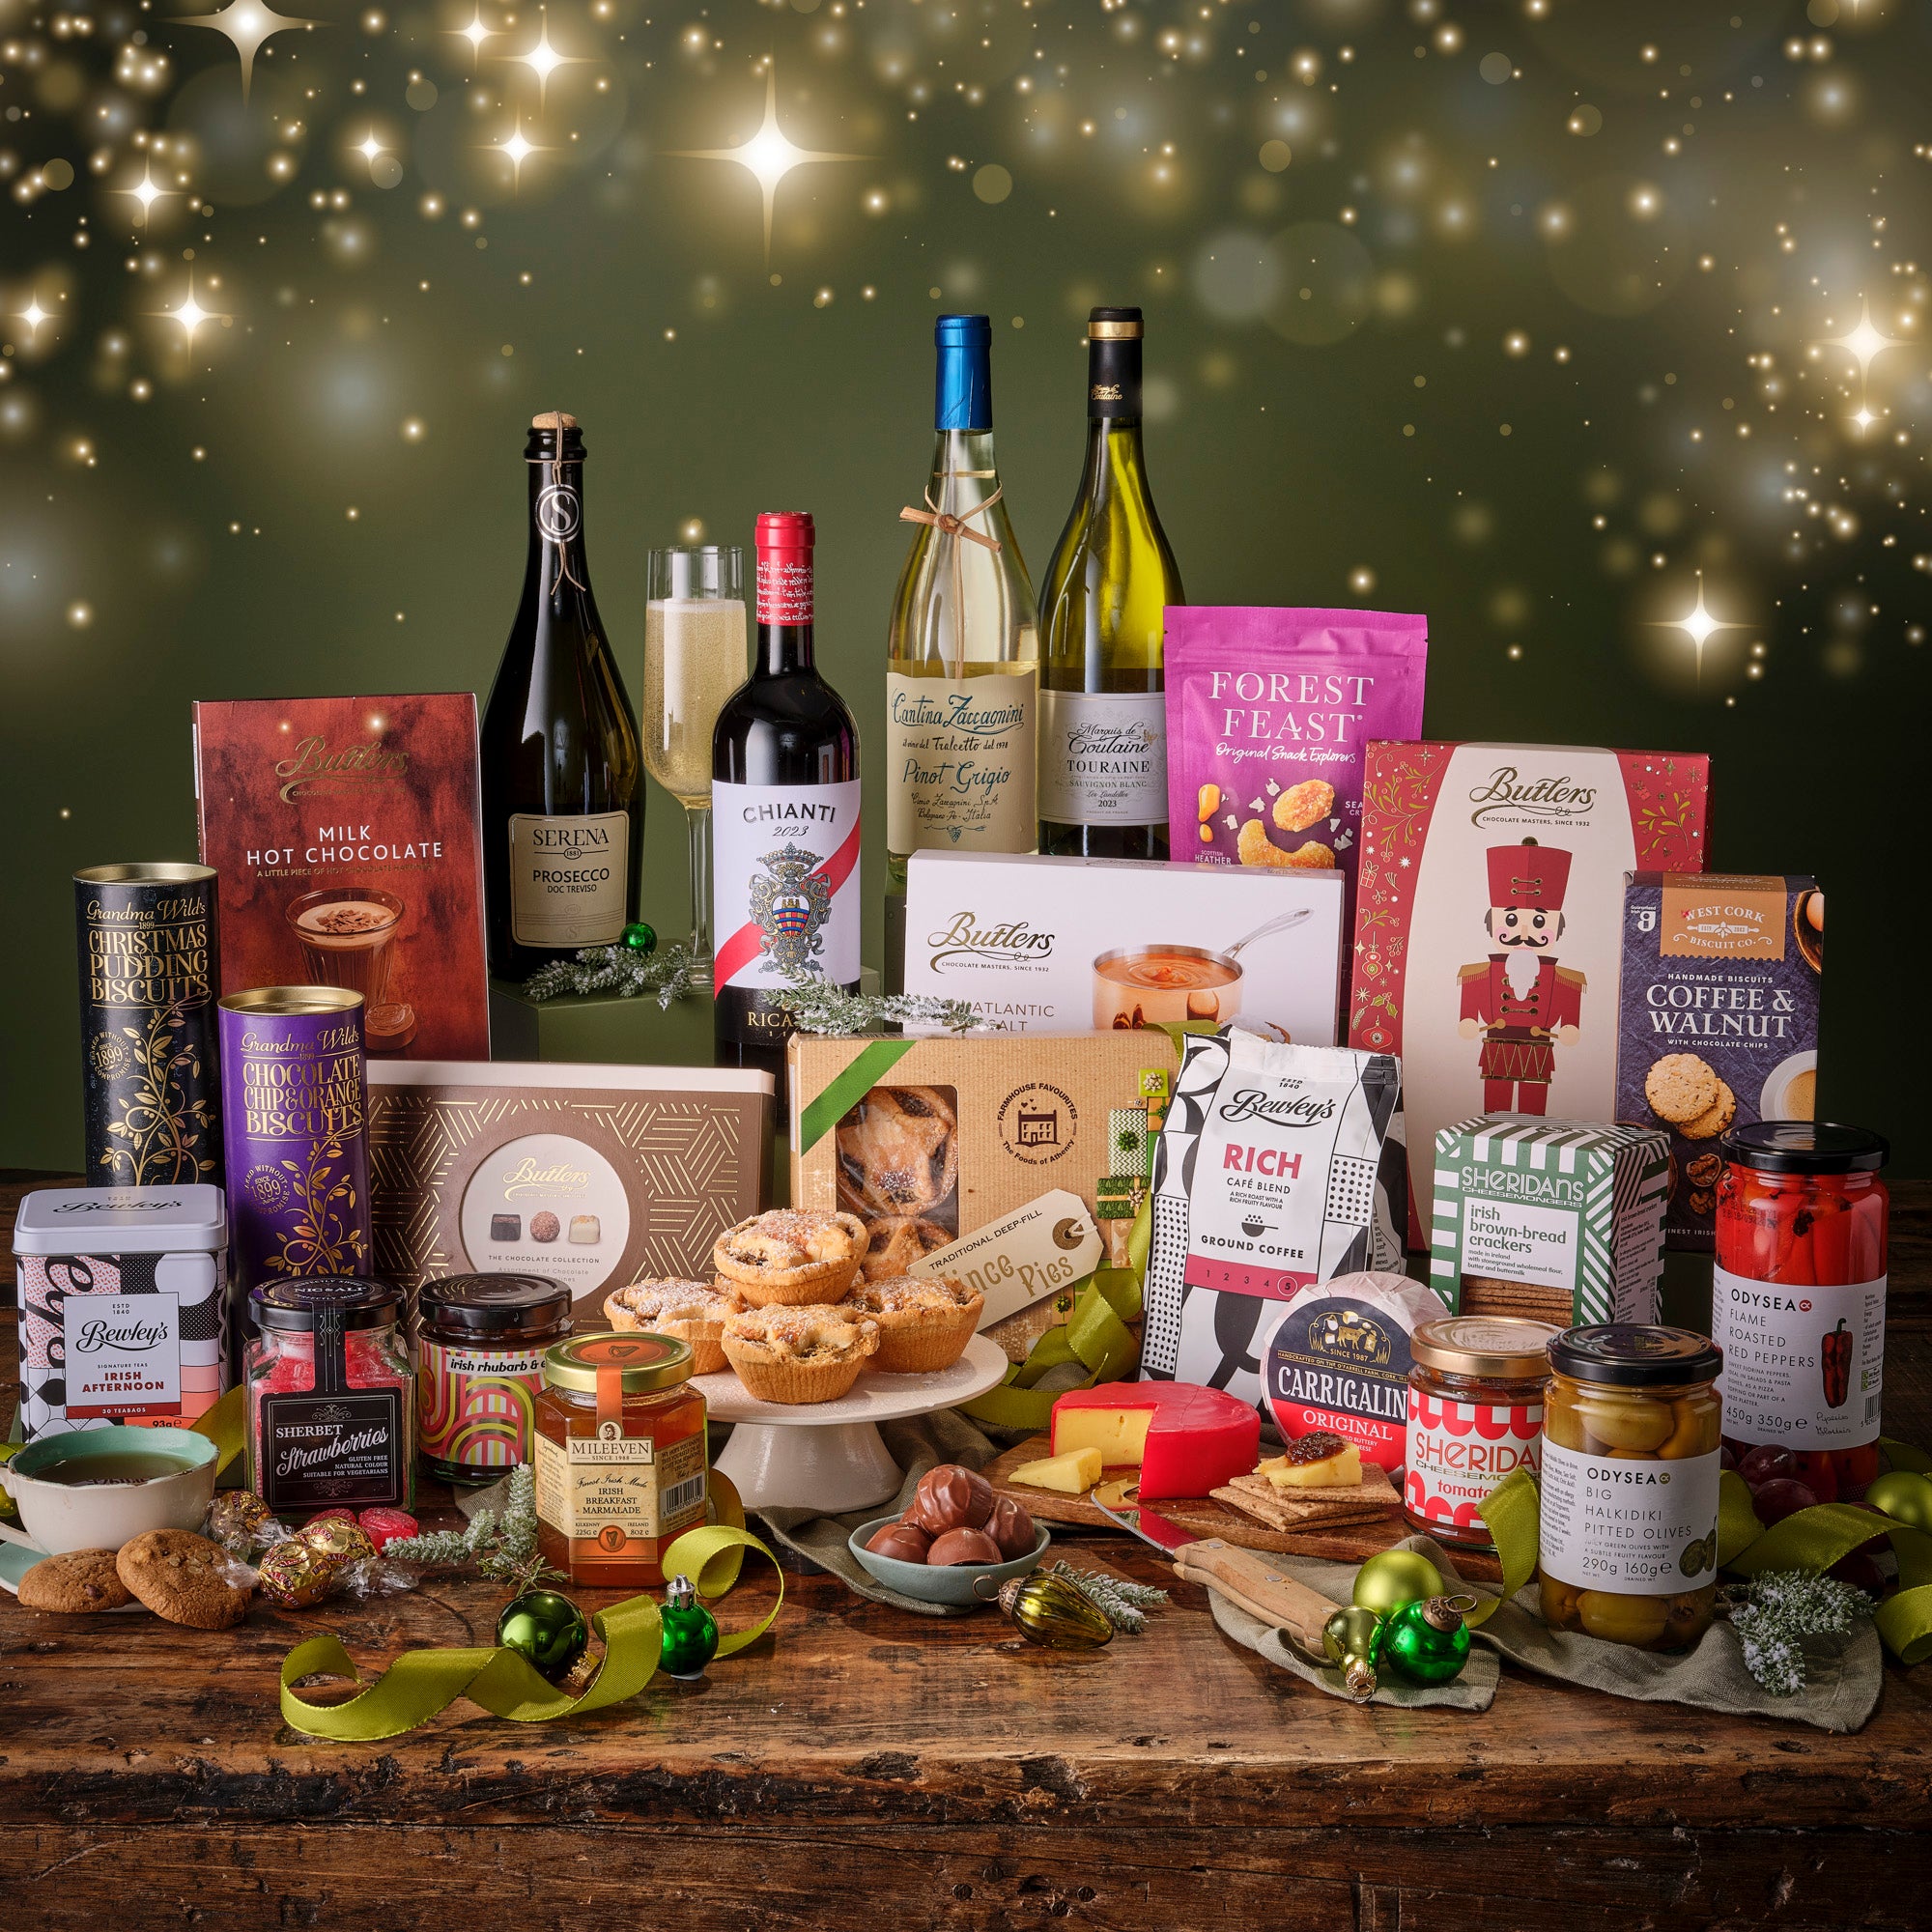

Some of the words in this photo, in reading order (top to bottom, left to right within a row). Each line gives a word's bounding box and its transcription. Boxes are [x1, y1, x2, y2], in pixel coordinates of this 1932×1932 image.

[1208, 671, 1374, 706] FOREST
[893, 692, 943, 726] Cantina
[943, 695, 1024, 730] Zaccagnini
[1221, 709, 1354, 743] FEAST
[1067, 732, 1149, 753] Goulaine
[1216, 742, 1268, 763] Original
[1271, 746, 1308, 761] Snack
[1310, 748, 1356, 765] Explorers
[275, 735, 410, 782] Butlers
[1067, 760, 1150, 773] TOURAINE
[903, 758, 952, 784] Pinot
[951, 761, 1011, 795] Grigio
[1469, 767, 1597, 812] Butlers
[743, 804, 836, 823] CHIANTI
[319, 825, 371, 842] MILK
[533, 829, 610, 846] SERENA
[773, 826, 810, 837] 2023
[246, 848, 295, 866] HOT
[305, 842, 442, 864] CHOCOLATE
[1195, 854, 1232, 865] HEATHER
[533, 868, 610, 883] PROSECCO
[548, 885, 564, 894] DOC
[567, 884, 597, 894] TREVISO
[87, 900, 155, 921] Grandma
[156, 896, 206, 920] Wild's
[1685, 906, 1721, 923] WEST
[1724, 906, 1765, 923] CORK
[89, 923, 207, 954] CHRISTMAS
[928, 912, 1055, 957] Butlers
[1690, 937, 1734, 950] BISCUIT
[90, 950, 208, 978] PUDDING
[1668, 973, 1723, 981] HANDMADE
[92, 974, 209, 1003] BISCUITS
[1647, 984, 1764, 1010] COFFEE
[1773, 990, 1795, 1012] &
[973, 1002, 1055, 1017] ATLANTIC
[1648, 1010, 1791, 1038] WALNUT
[241, 1032, 314, 1052] Grandma
[317, 1025, 359, 1048] Wild's
[96, 1046, 123, 1066] 1899
[242, 1053, 360, 1088] CHOCOLATE
[997, 1083, 1037, 1121] FARMHOUSE
[1038, 1083, 1078, 1120] FAVOURITES
[1219, 1089, 1337, 1126] Bewley's
[246, 1102, 363, 1136] BISCUITS
[1003, 1141, 1014, 1154] The
[1014, 1152, 1037, 1165] Foods
[1050, 1139, 1074, 1163] Athenry
[1223, 1143, 1302, 1179] RICH
[503, 1158, 591, 1189] Butlers
[251, 1179, 280, 1200] 1899
[1227, 1178, 1253, 1189] CAFÉ
[1257, 1181, 1291, 1194] BLEND
[1462, 1186, 1582, 1208] CHEESEMONGERS
[1242, 1198, 1259, 1207] FRUITY
[1470, 1205, 1500, 1221] irish
[928, 1235, 994, 1270] TRADITIONAL
[994, 1210, 1043, 1238] DEEP-FILL
[1469, 1219, 1566, 1244] brown-bread
[1201, 1235, 1254, 1251] GROUND
[1259, 1244, 1304, 1260] COFFEE
[1469, 1235, 1532, 1254] crackers
[1017, 1256, 1074, 1298] Pies
[1731, 1289, 1797, 1312] ODYSEA
[1730, 1308, 1767, 1327] FLAME
[75, 1320, 168, 1353] Bewley's
[1729, 1326, 1786, 1348] ROASTED
[450, 1359, 474, 1371] irish
[477, 1361, 527, 1372] rhubarb
[530, 1360, 539, 1370] &
[1330, 1348, 1350, 1358] SINCE
[1352, 1352, 1368, 1363] 1987
[1728, 1345, 1748, 1359] RED
[1754, 1351, 1815, 1368] PEPPERS
[82, 1381, 164, 1393] AFTERNOON
[104, 1372, 142, 1381] IRISH
[1278, 1366, 1408, 1420] CARRIGALIN
[1303, 1410, 1392, 1440] ORIGINAL
[1726, 1406, 1752, 1425] 450g
[276, 1425, 343, 1438] SHERBET
[276, 1427, 388, 1476] Strawberries
[571, 1442, 650, 1455] MILEEVEN
[601, 1473, 623, 1484] Irish
[1587, 1467, 1657, 1485] ODYSEA
[1586, 1487, 1612, 1500] BIG
[1585, 1505, 1662, 1521] HALKIDIKI
[1585, 1522, 1634, 1539] PITTED
[1643, 1526, 1691, 1540] OLIVES
[1582, 1556, 1618, 1575] 290g
